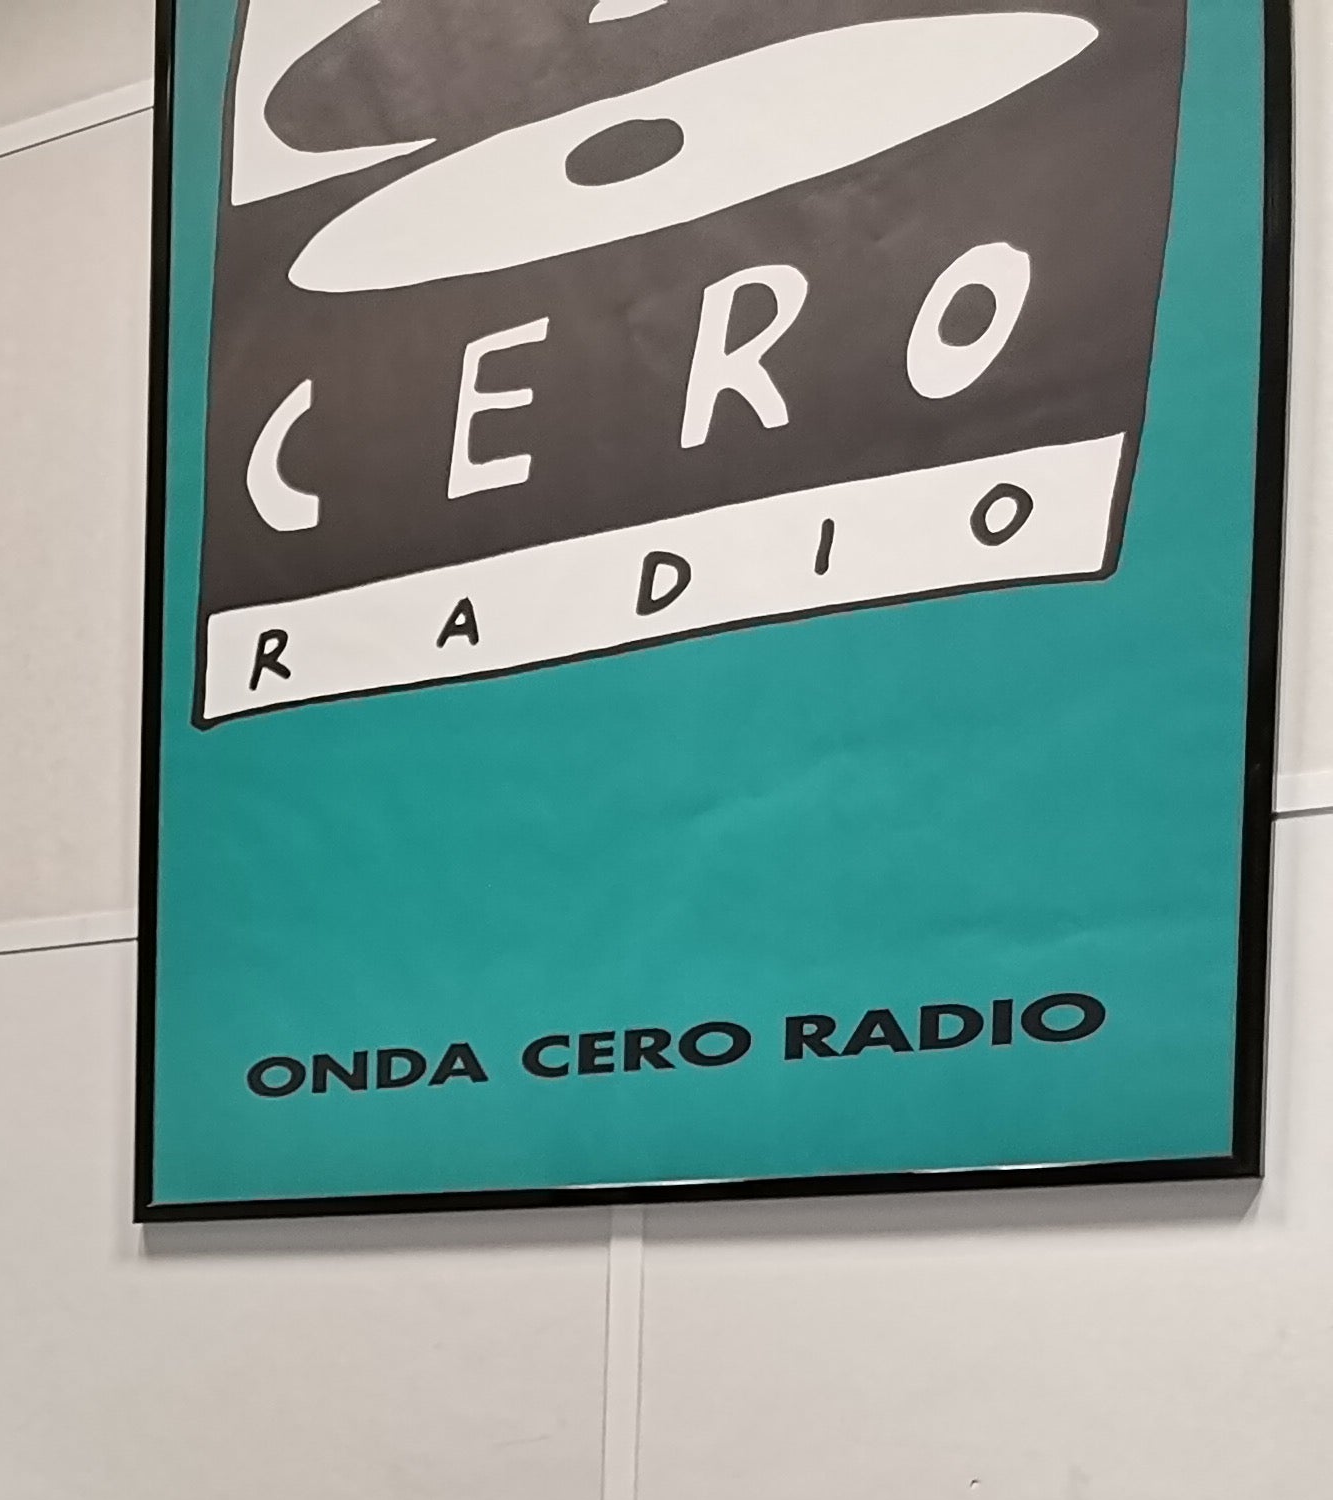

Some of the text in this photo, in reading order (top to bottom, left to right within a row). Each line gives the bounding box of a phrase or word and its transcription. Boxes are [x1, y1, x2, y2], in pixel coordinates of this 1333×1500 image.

[245, 241, 1031, 533] CERO
[248, 481, 1034, 691] RADIO
[245, 991, 1108, 1099] ONDA CERO RADIO
